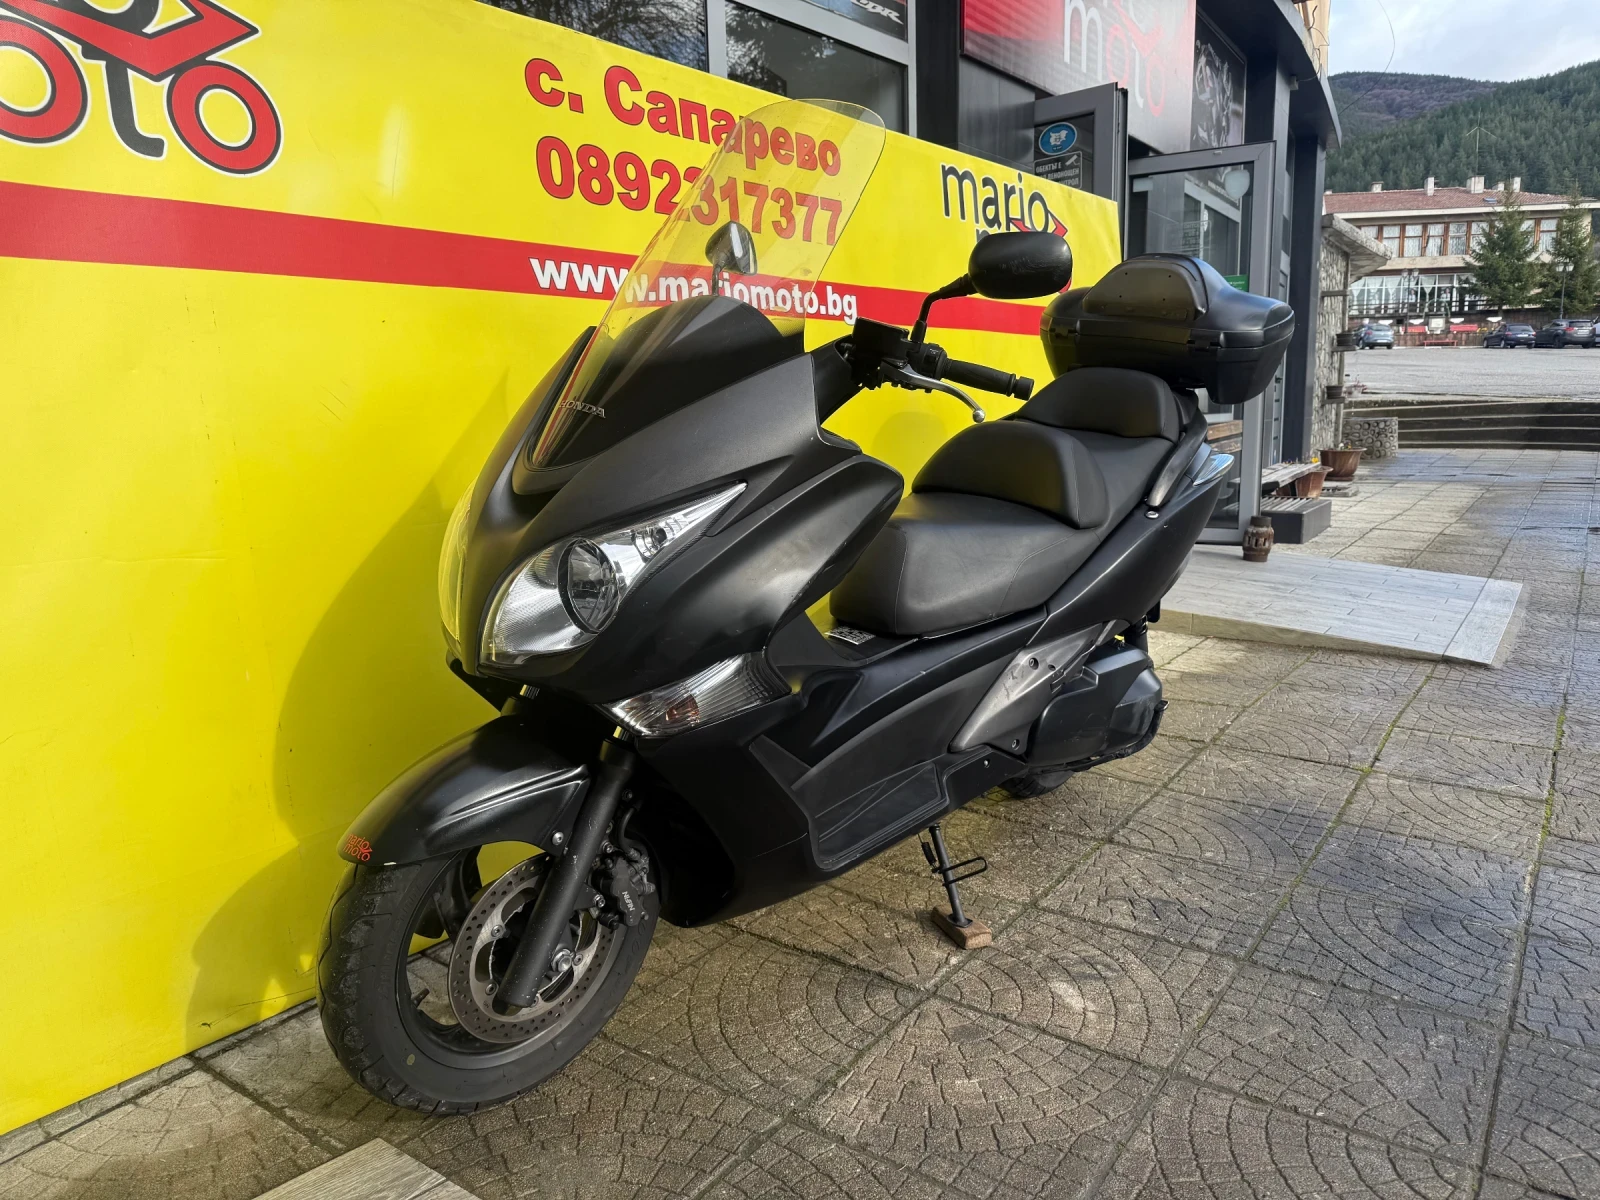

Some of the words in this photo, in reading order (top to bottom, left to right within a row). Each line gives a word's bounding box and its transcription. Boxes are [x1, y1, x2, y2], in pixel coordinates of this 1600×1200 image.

[0, 15, 283, 175] oto
[524, 57, 584, 113] с.
[604, 65, 841, 176] Сапарево
[536, 135, 843, 245] 0892317377
[941, 163, 1049, 232] mario
[559, 400, 606, 418] HONDA
